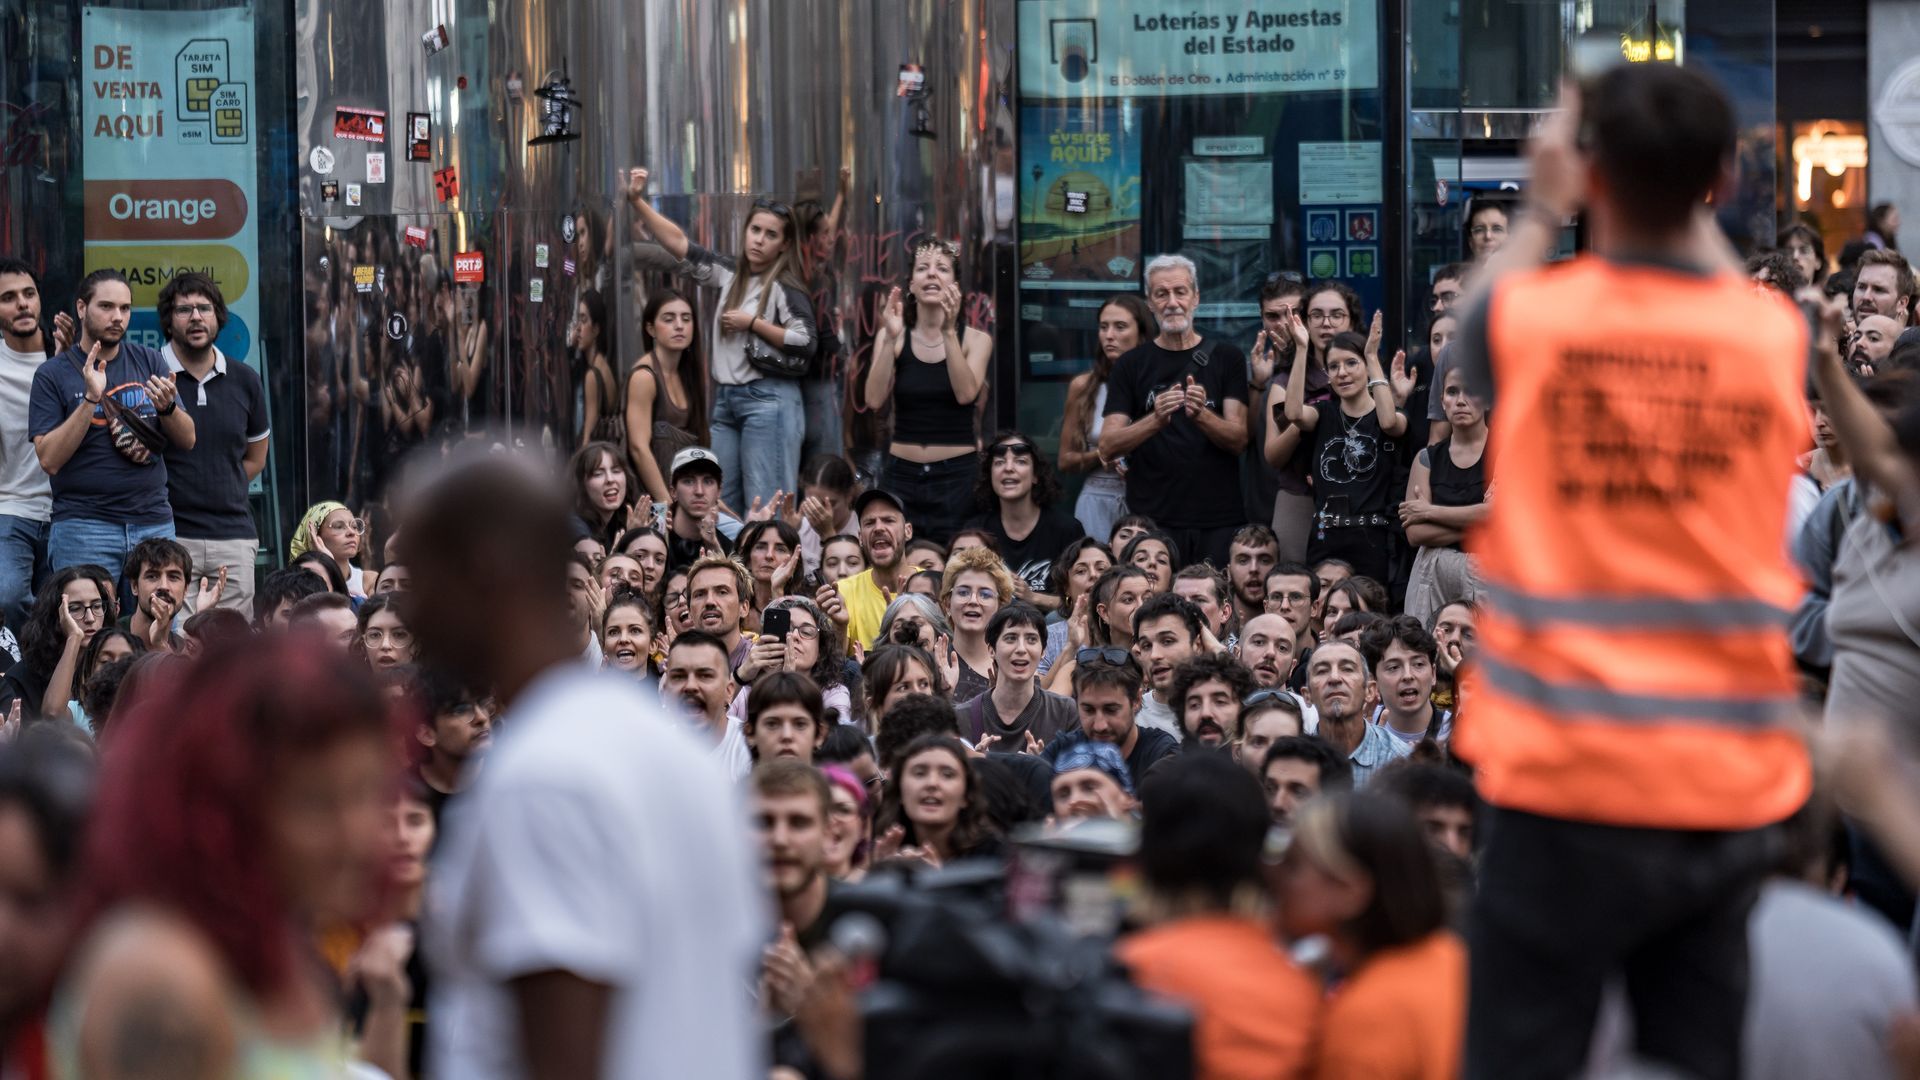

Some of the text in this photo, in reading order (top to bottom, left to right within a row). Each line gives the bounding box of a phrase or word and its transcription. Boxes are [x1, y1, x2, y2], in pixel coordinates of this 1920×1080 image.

[1133, 9, 1342, 34] Loterías y Apuestas
[1184, 34, 1295, 55] del Estado
[94, 45, 133, 70] DE
[183, 54, 221, 62] TARJETA
[191, 63, 213, 73] SIM
[1122, 72, 1165, 86] Doblón
[1168, 74, 1184, 85] de
[1187, 73, 1211, 84] Oro
[1225, 70, 1315, 84] Administración
[93, 81, 163, 99] VENTA
[220, 91, 236, 99] SIM
[215, 99, 241, 107] CARD
[94, 110, 164, 141] AQUÍ
[182, 130, 202, 138] eSIM
[109, 193, 217, 225] Orange
